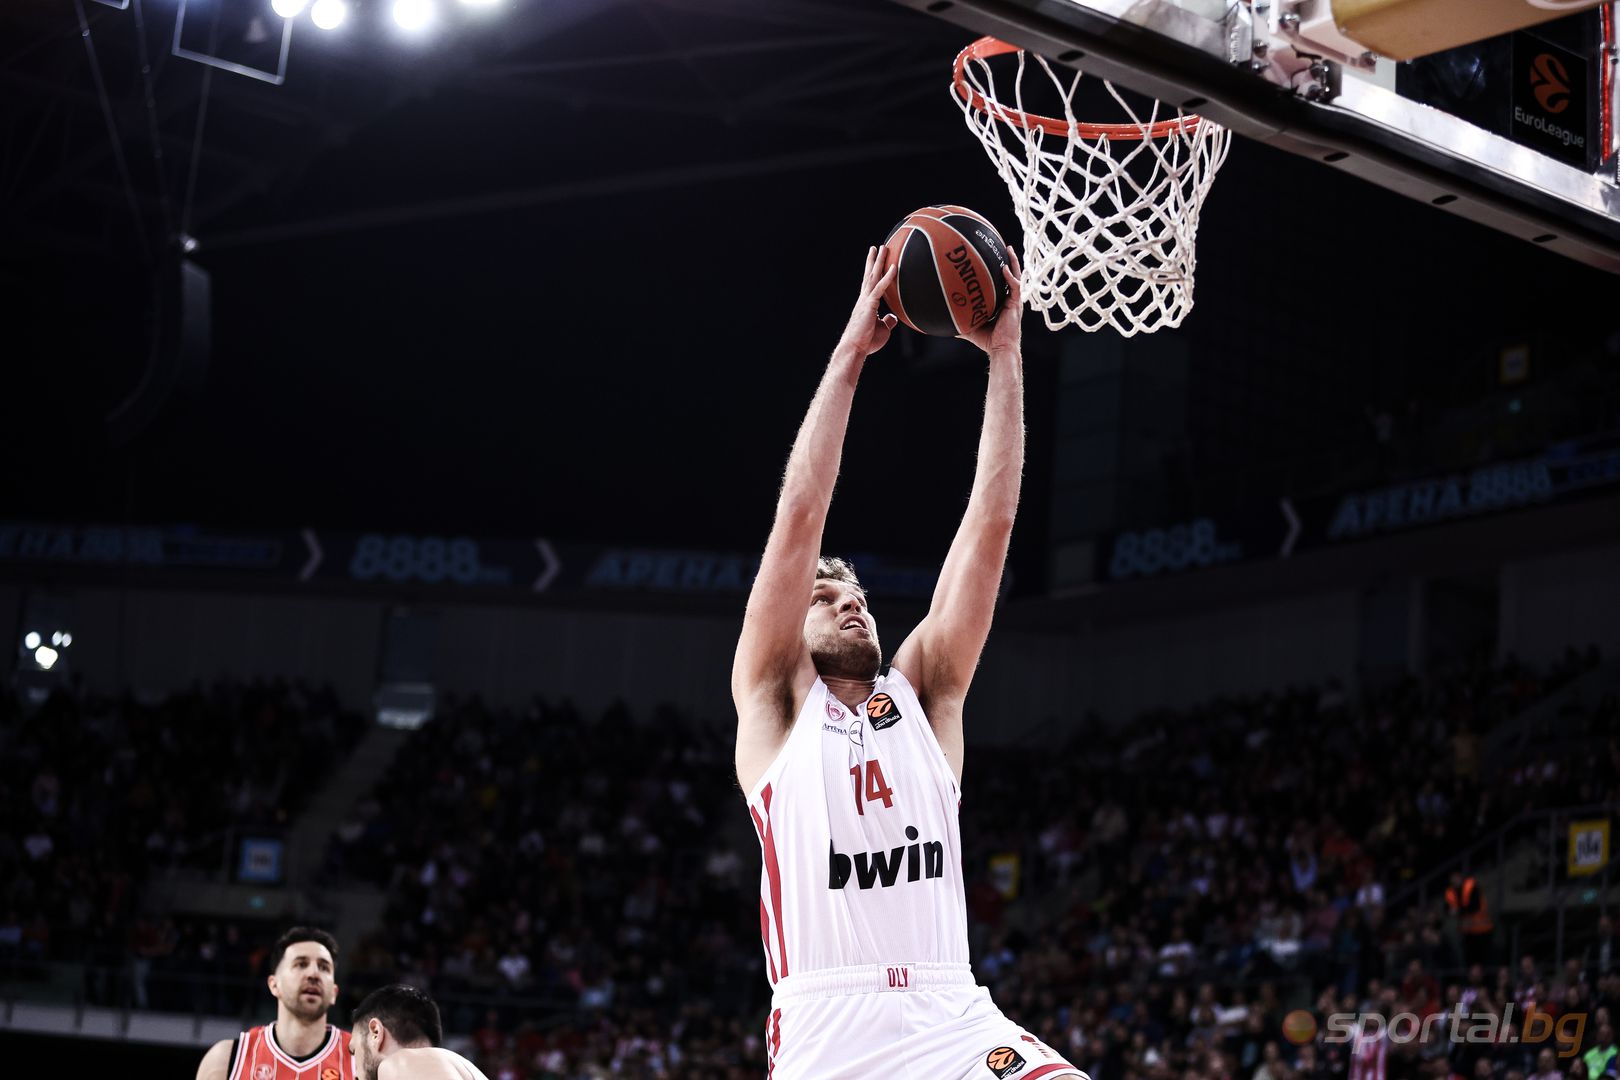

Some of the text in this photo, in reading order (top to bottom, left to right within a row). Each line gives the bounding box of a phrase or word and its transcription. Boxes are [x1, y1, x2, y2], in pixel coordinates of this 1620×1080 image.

[1514, 106, 1585, 147] EuroLeague
[945, 245, 990, 328] PALDING
[850, 759, 894, 816] 14
[828, 825, 944, 890] bwin
